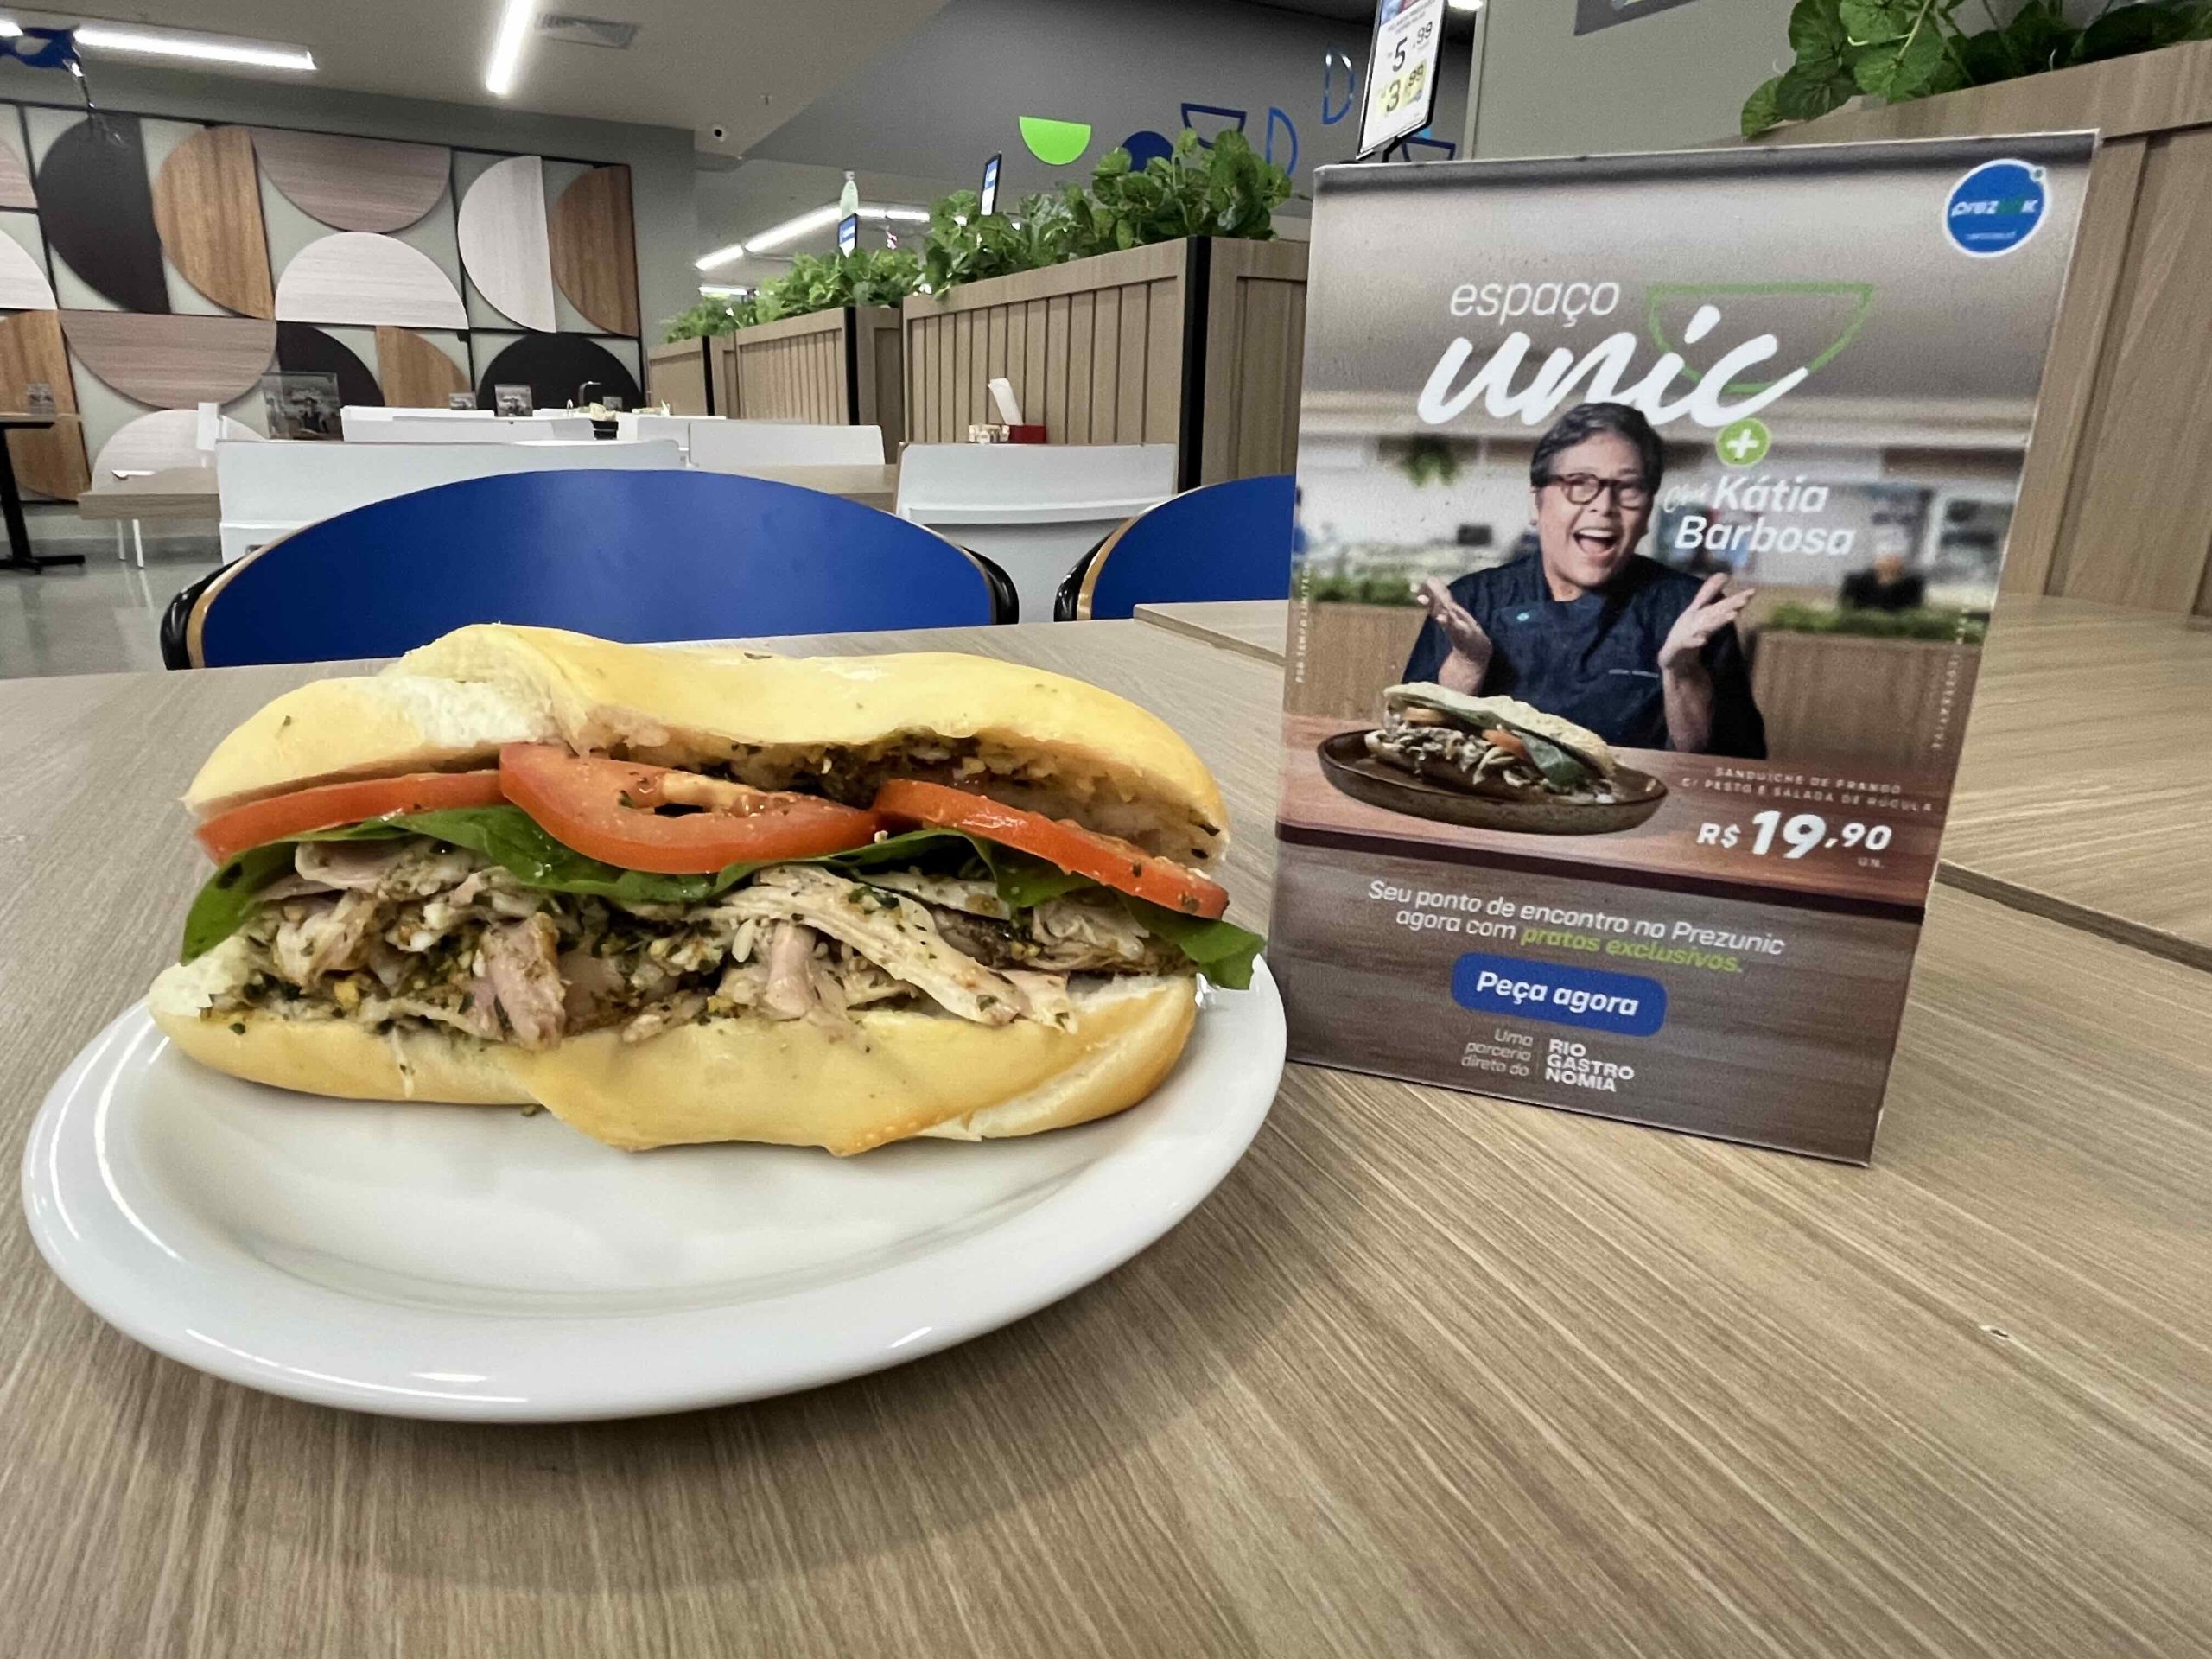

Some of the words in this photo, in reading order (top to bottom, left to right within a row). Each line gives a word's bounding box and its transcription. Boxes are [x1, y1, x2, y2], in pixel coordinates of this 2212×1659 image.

[1450, 281, 1621, 328] espaço
[1417, 305, 1808, 426] unic
[1713, 474, 1830, 513] Kátia
[1675, 514, 1856, 556] Barbosa
[1696, 822, 1742, 849] R$
[1752, 810, 1892, 859] 19,90
[1368, 880, 1412, 903] Seu
[1415, 890, 1482, 913] ponto
[1486, 896, 1516, 918] de
[1520, 905, 1629, 933] encontro
[1633, 919, 1665, 938] no
[1671, 921, 1786, 955] Prezunic
[1395, 909, 1462, 931] agora
[1466, 919, 1516, 940] com
[1520, 927, 1600, 951] pratos
[1605, 938, 1743, 973] exclusivos.
[1476, 970, 1548, 1006] Peça
[1553, 988, 1639, 1016] agora
[1464, 1042, 1532, 1063] parceria
[1494, 1027, 1534, 1047] Uma
[1548, 1038, 1586, 1057] RIO
[1461, 1053, 1507, 1073] direto
[1509, 1062, 1530, 1077] do
[1544, 1067, 1617, 1092] NOMIA
[1546, 1053, 1635, 1080] GASTRO
